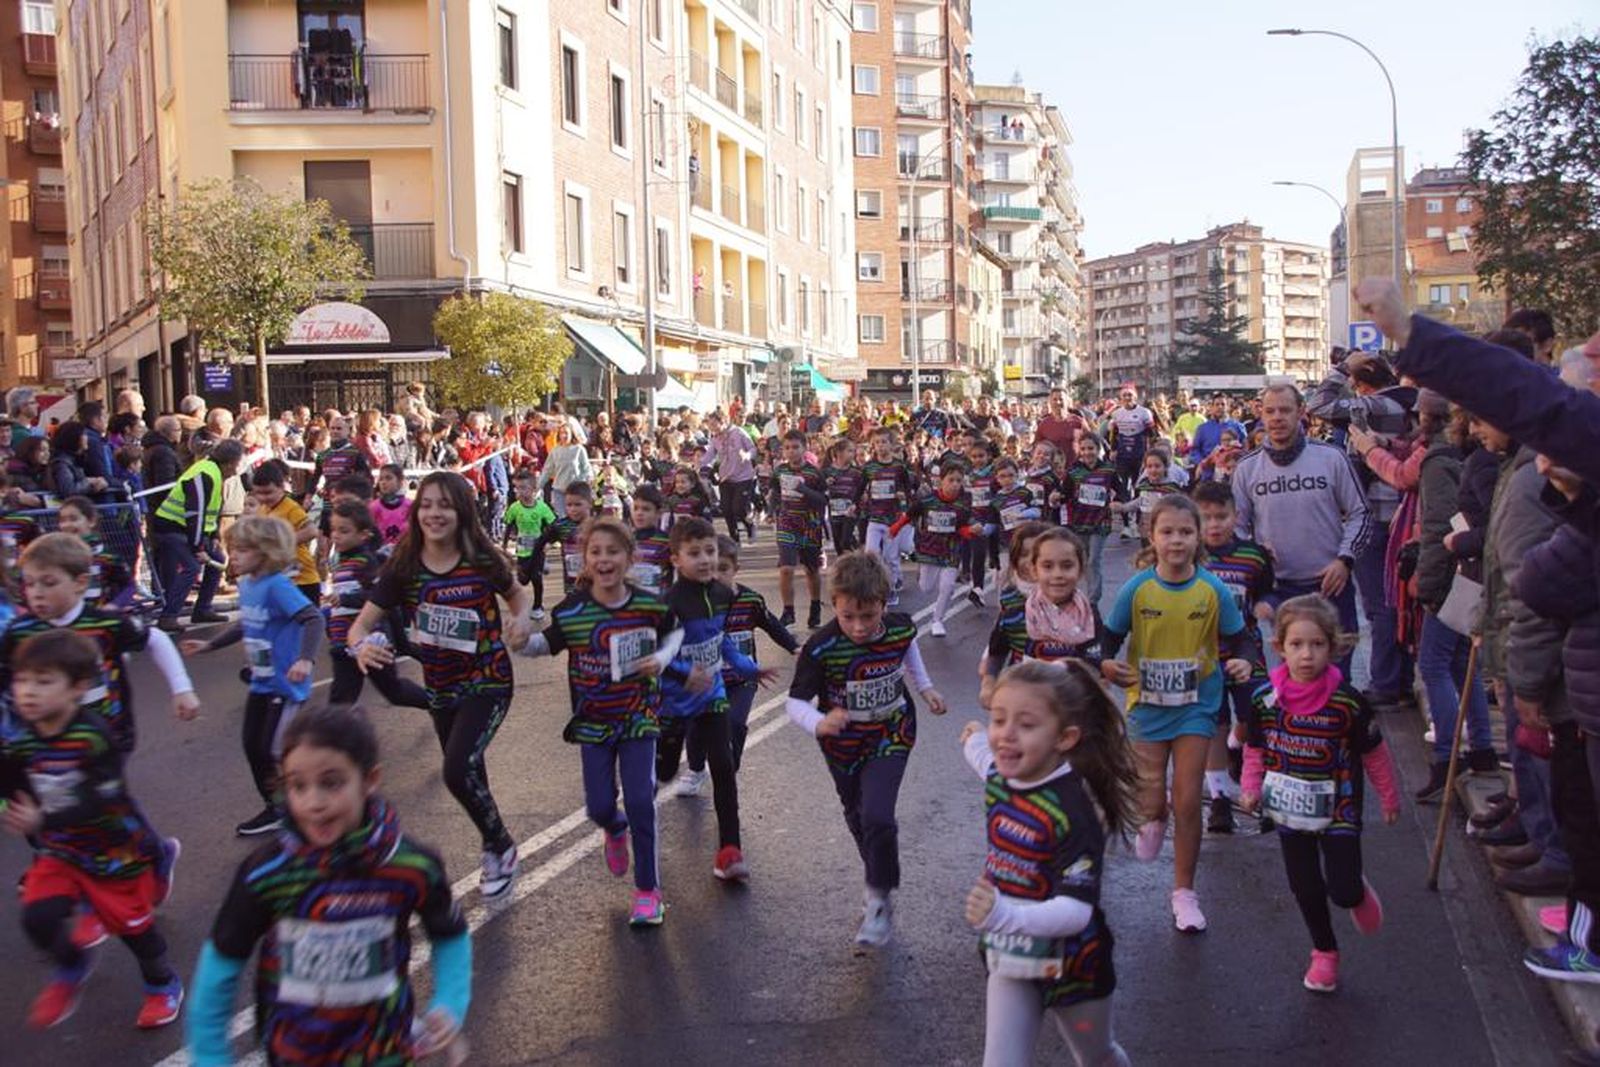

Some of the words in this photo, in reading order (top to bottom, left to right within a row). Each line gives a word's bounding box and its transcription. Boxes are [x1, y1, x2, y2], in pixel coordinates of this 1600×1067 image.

[1355, 326, 1377, 349] P
[1255, 474, 1327, 496] adidas
[427, 616, 459, 636] 6112
[1146, 671, 1186, 691] 5973
[856, 681, 895, 709] 6348
[1270, 788, 1316, 814] 5969
